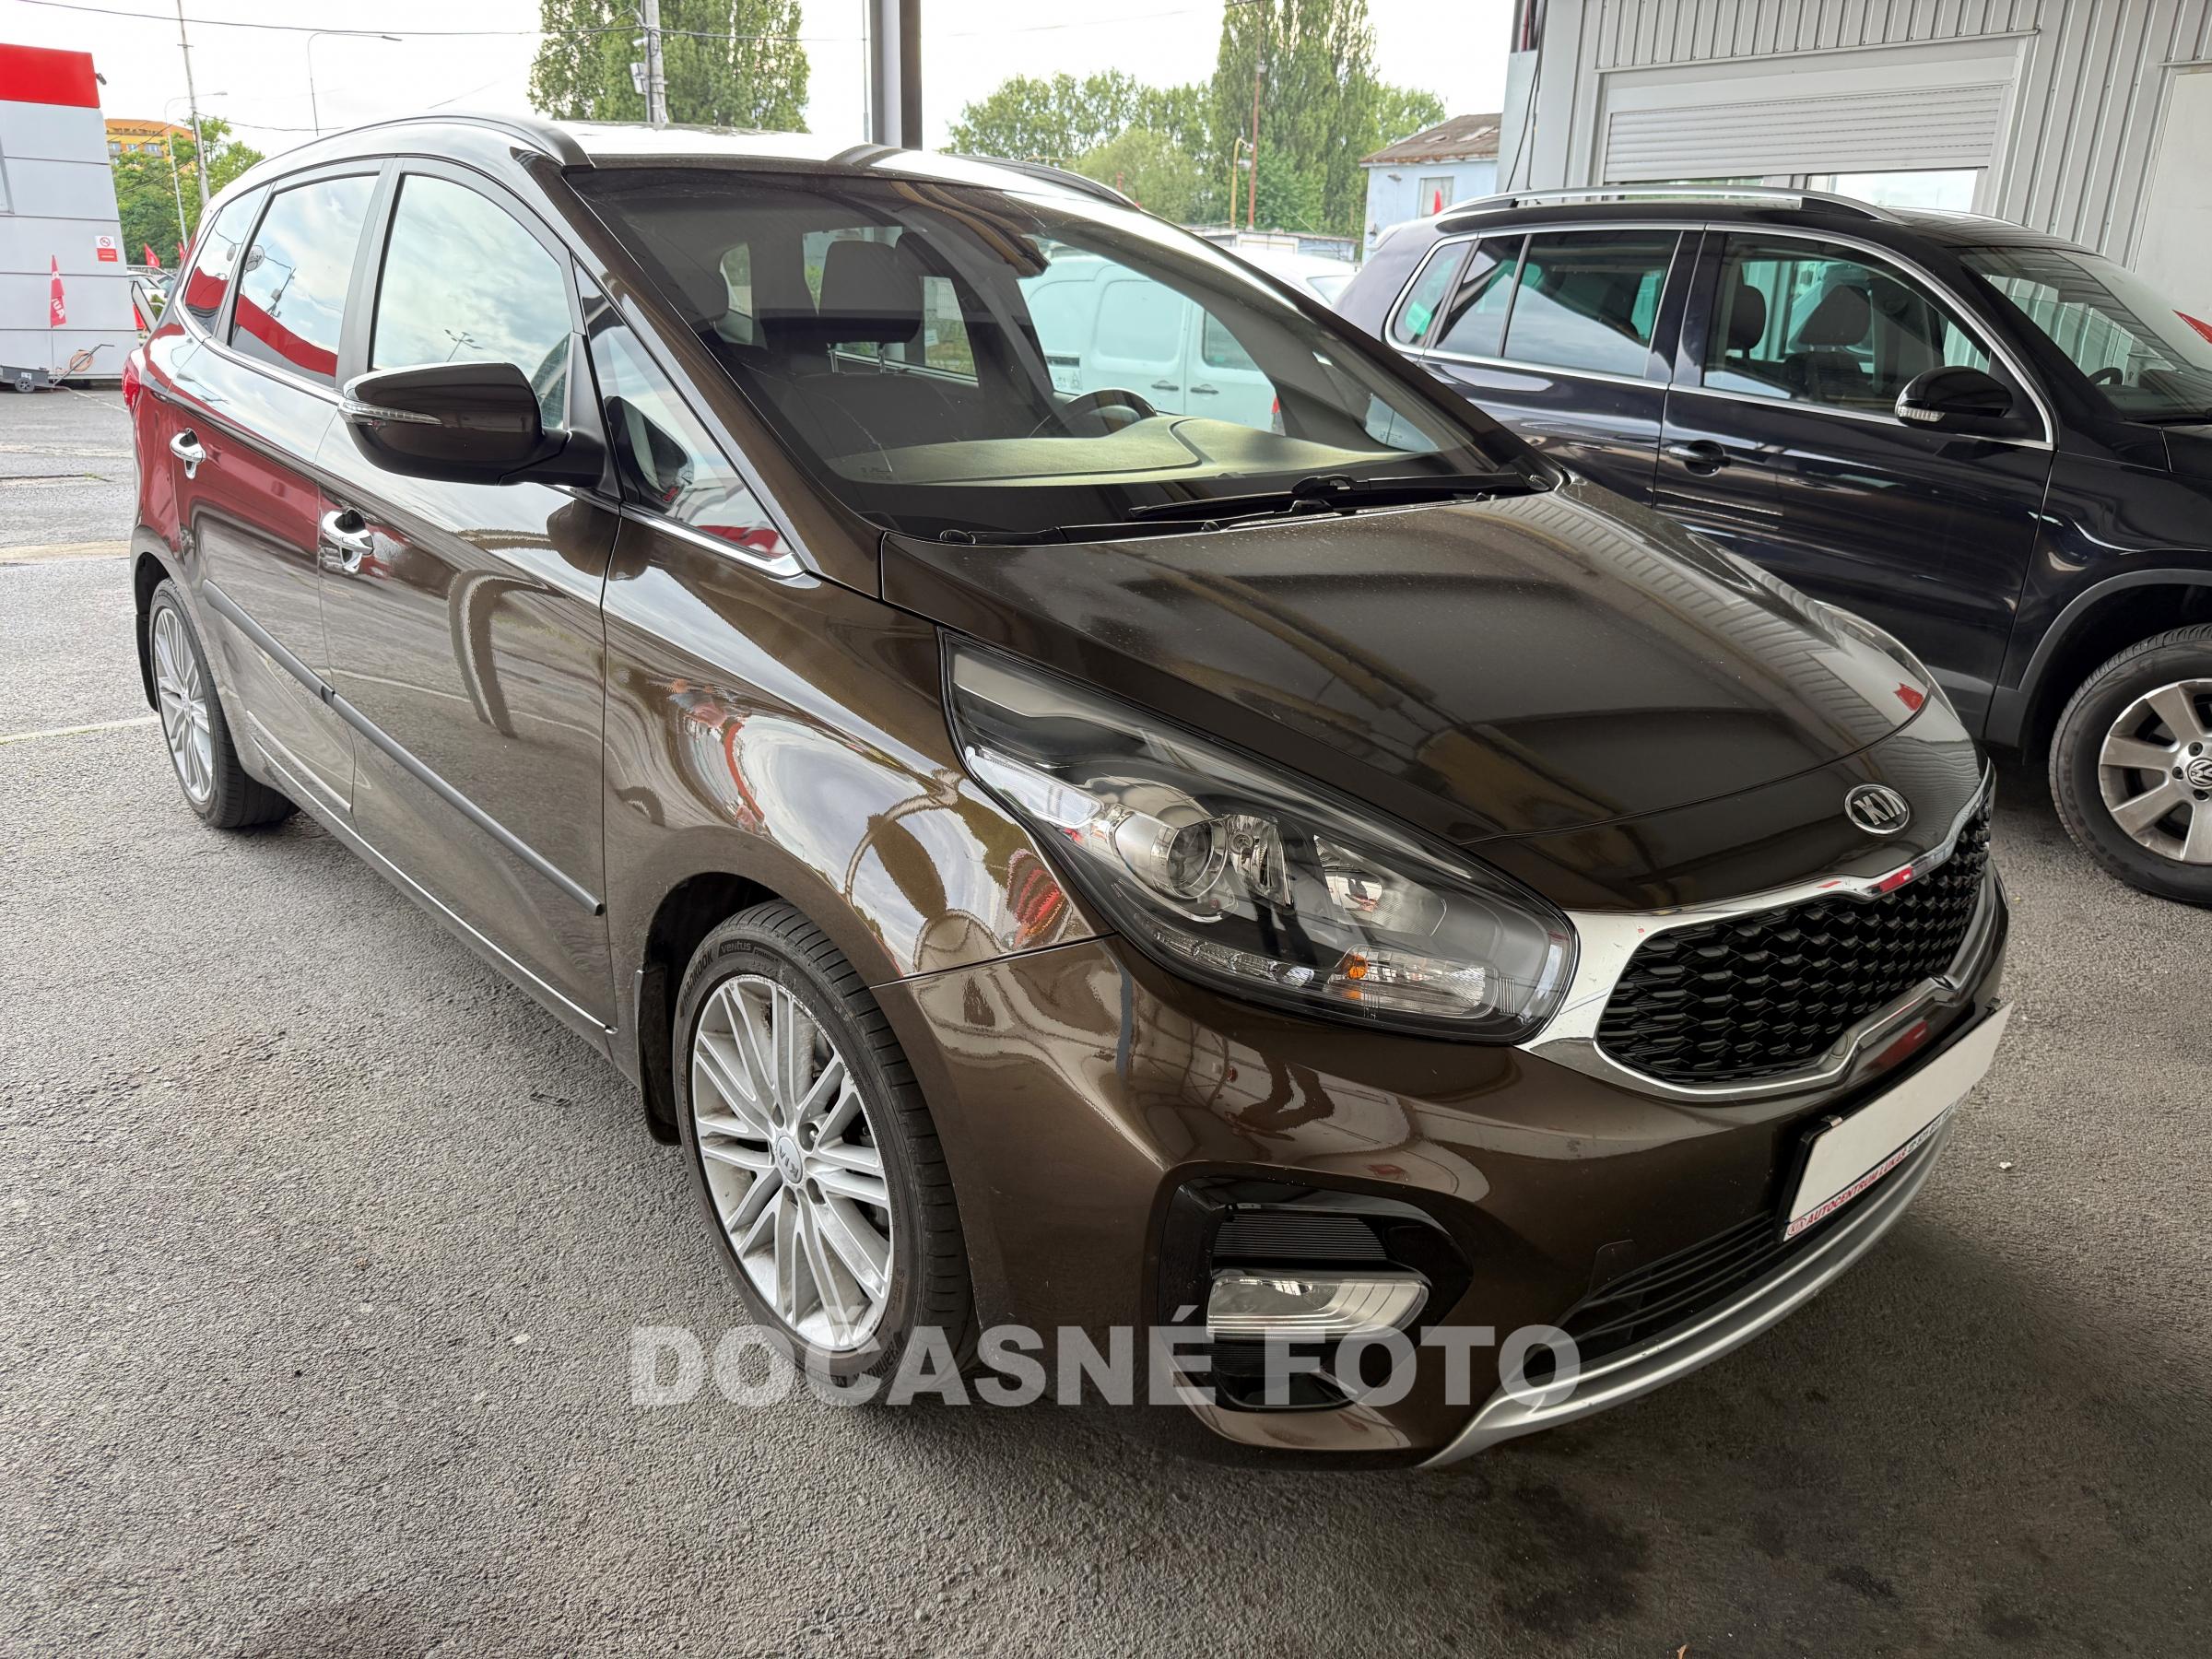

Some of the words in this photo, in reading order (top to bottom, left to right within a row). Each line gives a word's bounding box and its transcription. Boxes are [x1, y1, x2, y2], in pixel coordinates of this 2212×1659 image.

[1853, 789, 1907, 826] KIA
[778, 1145, 799, 1179] KIA
[1806, 1169, 1879, 1226] AUTOCENTRUM
